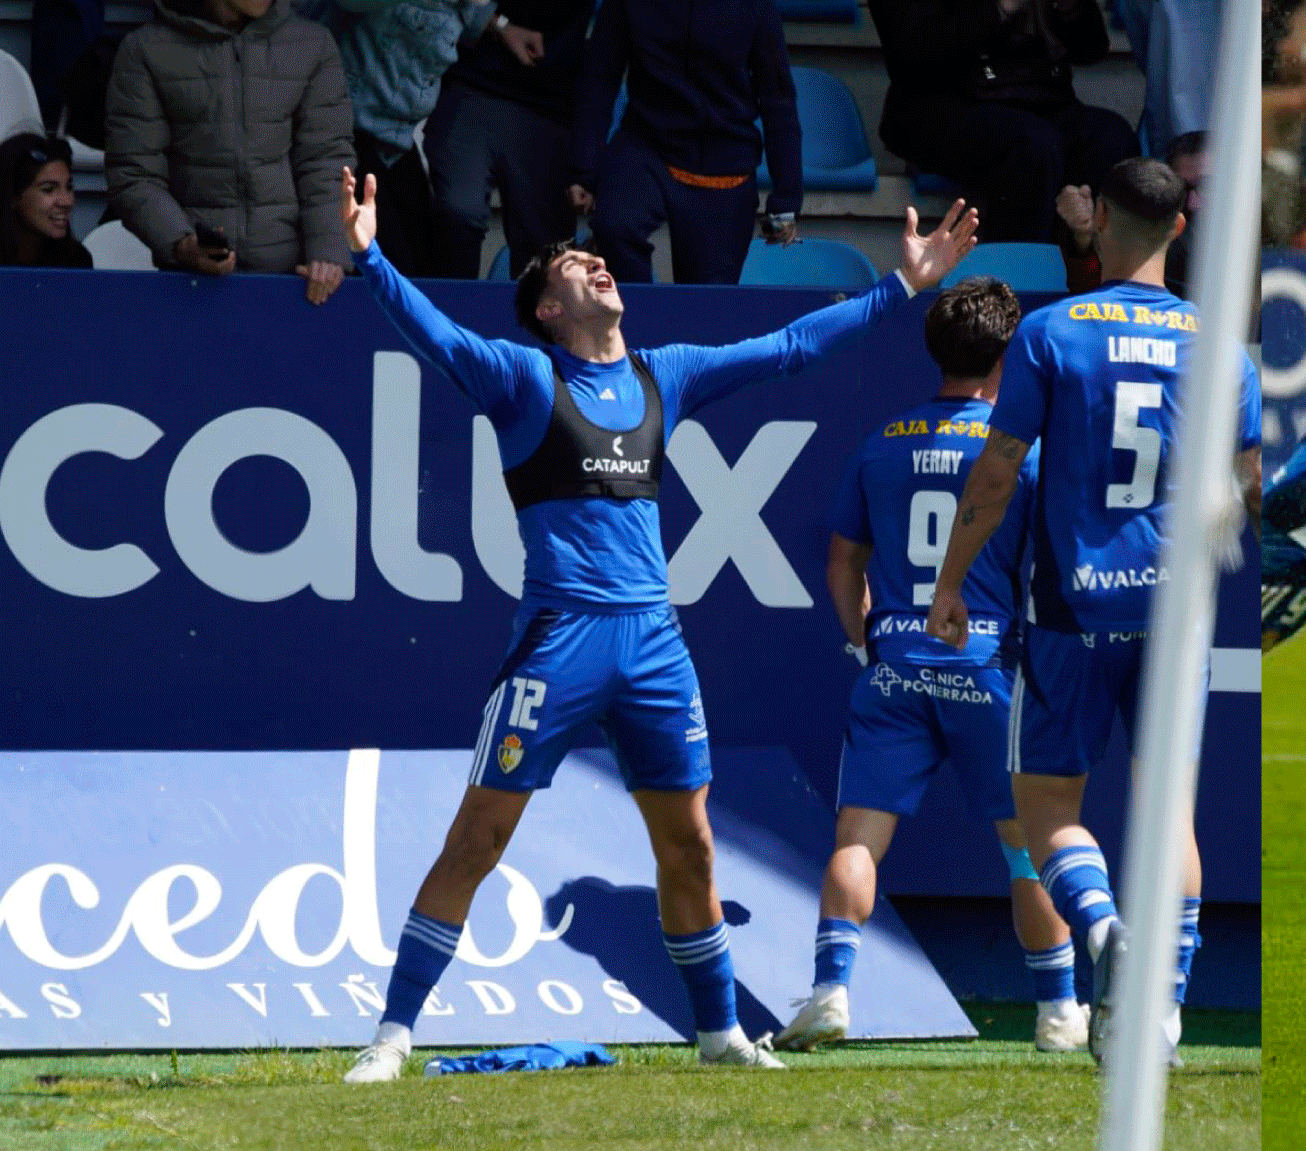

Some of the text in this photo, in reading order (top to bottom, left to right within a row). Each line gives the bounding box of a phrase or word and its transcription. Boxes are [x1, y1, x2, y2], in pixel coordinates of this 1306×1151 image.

[1069, 302, 1129, 323] CAJA
[1108, 336, 1176, 367] LANCHO
[883, 420, 929, 438] CAJA
[1106, 381, 1163, 509] 5
[581, 458, 650, 475] CATAPULT
[912, 449, 964, 475] YERAY
[907, 490, 958, 606] 9
[1098, 567, 1170, 589] VALCA
[919, 668, 976, 689] CNICA
[508, 677, 547, 731] 12
[139, 992, 171, 1028] y
[227, 974, 642, 1018] VIÑEDOS
